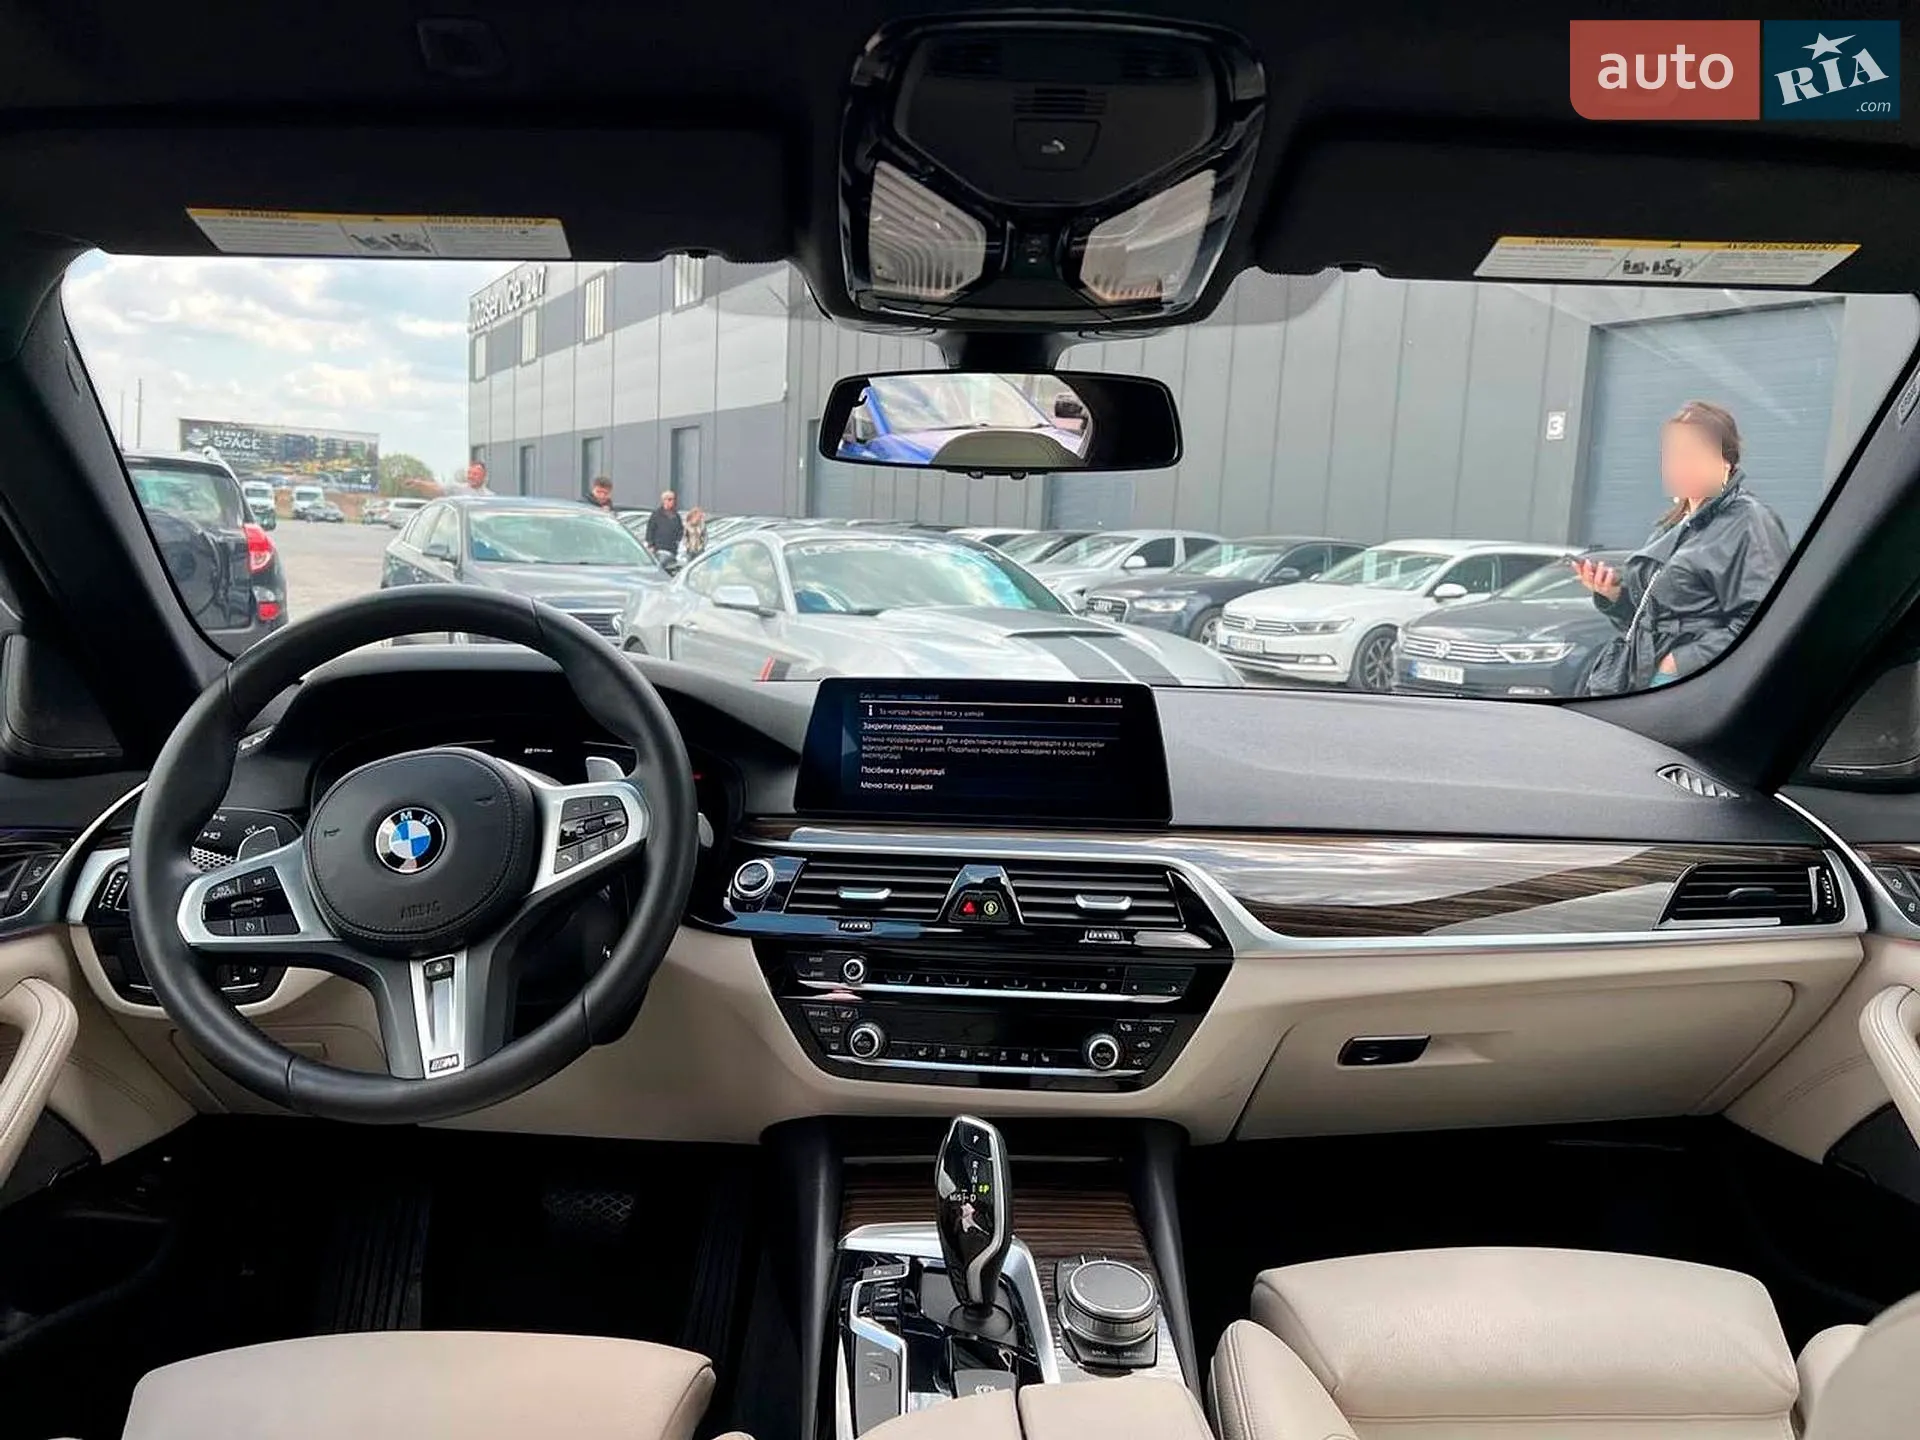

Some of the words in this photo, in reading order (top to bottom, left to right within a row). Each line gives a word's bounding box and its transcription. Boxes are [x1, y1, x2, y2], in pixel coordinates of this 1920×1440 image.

[1549, 414, 1563, 436] 3
[214, 437, 261, 450] SPACE
[862, 721, 892, 731] Закрити
[892, 722, 944, 731] повідомлення
[860, 765, 894, 774] Посібник
[900, 767, 945, 776] експлуатації
[860, 781, 883, 789] Меню
[883, 783, 903, 791] тиску
